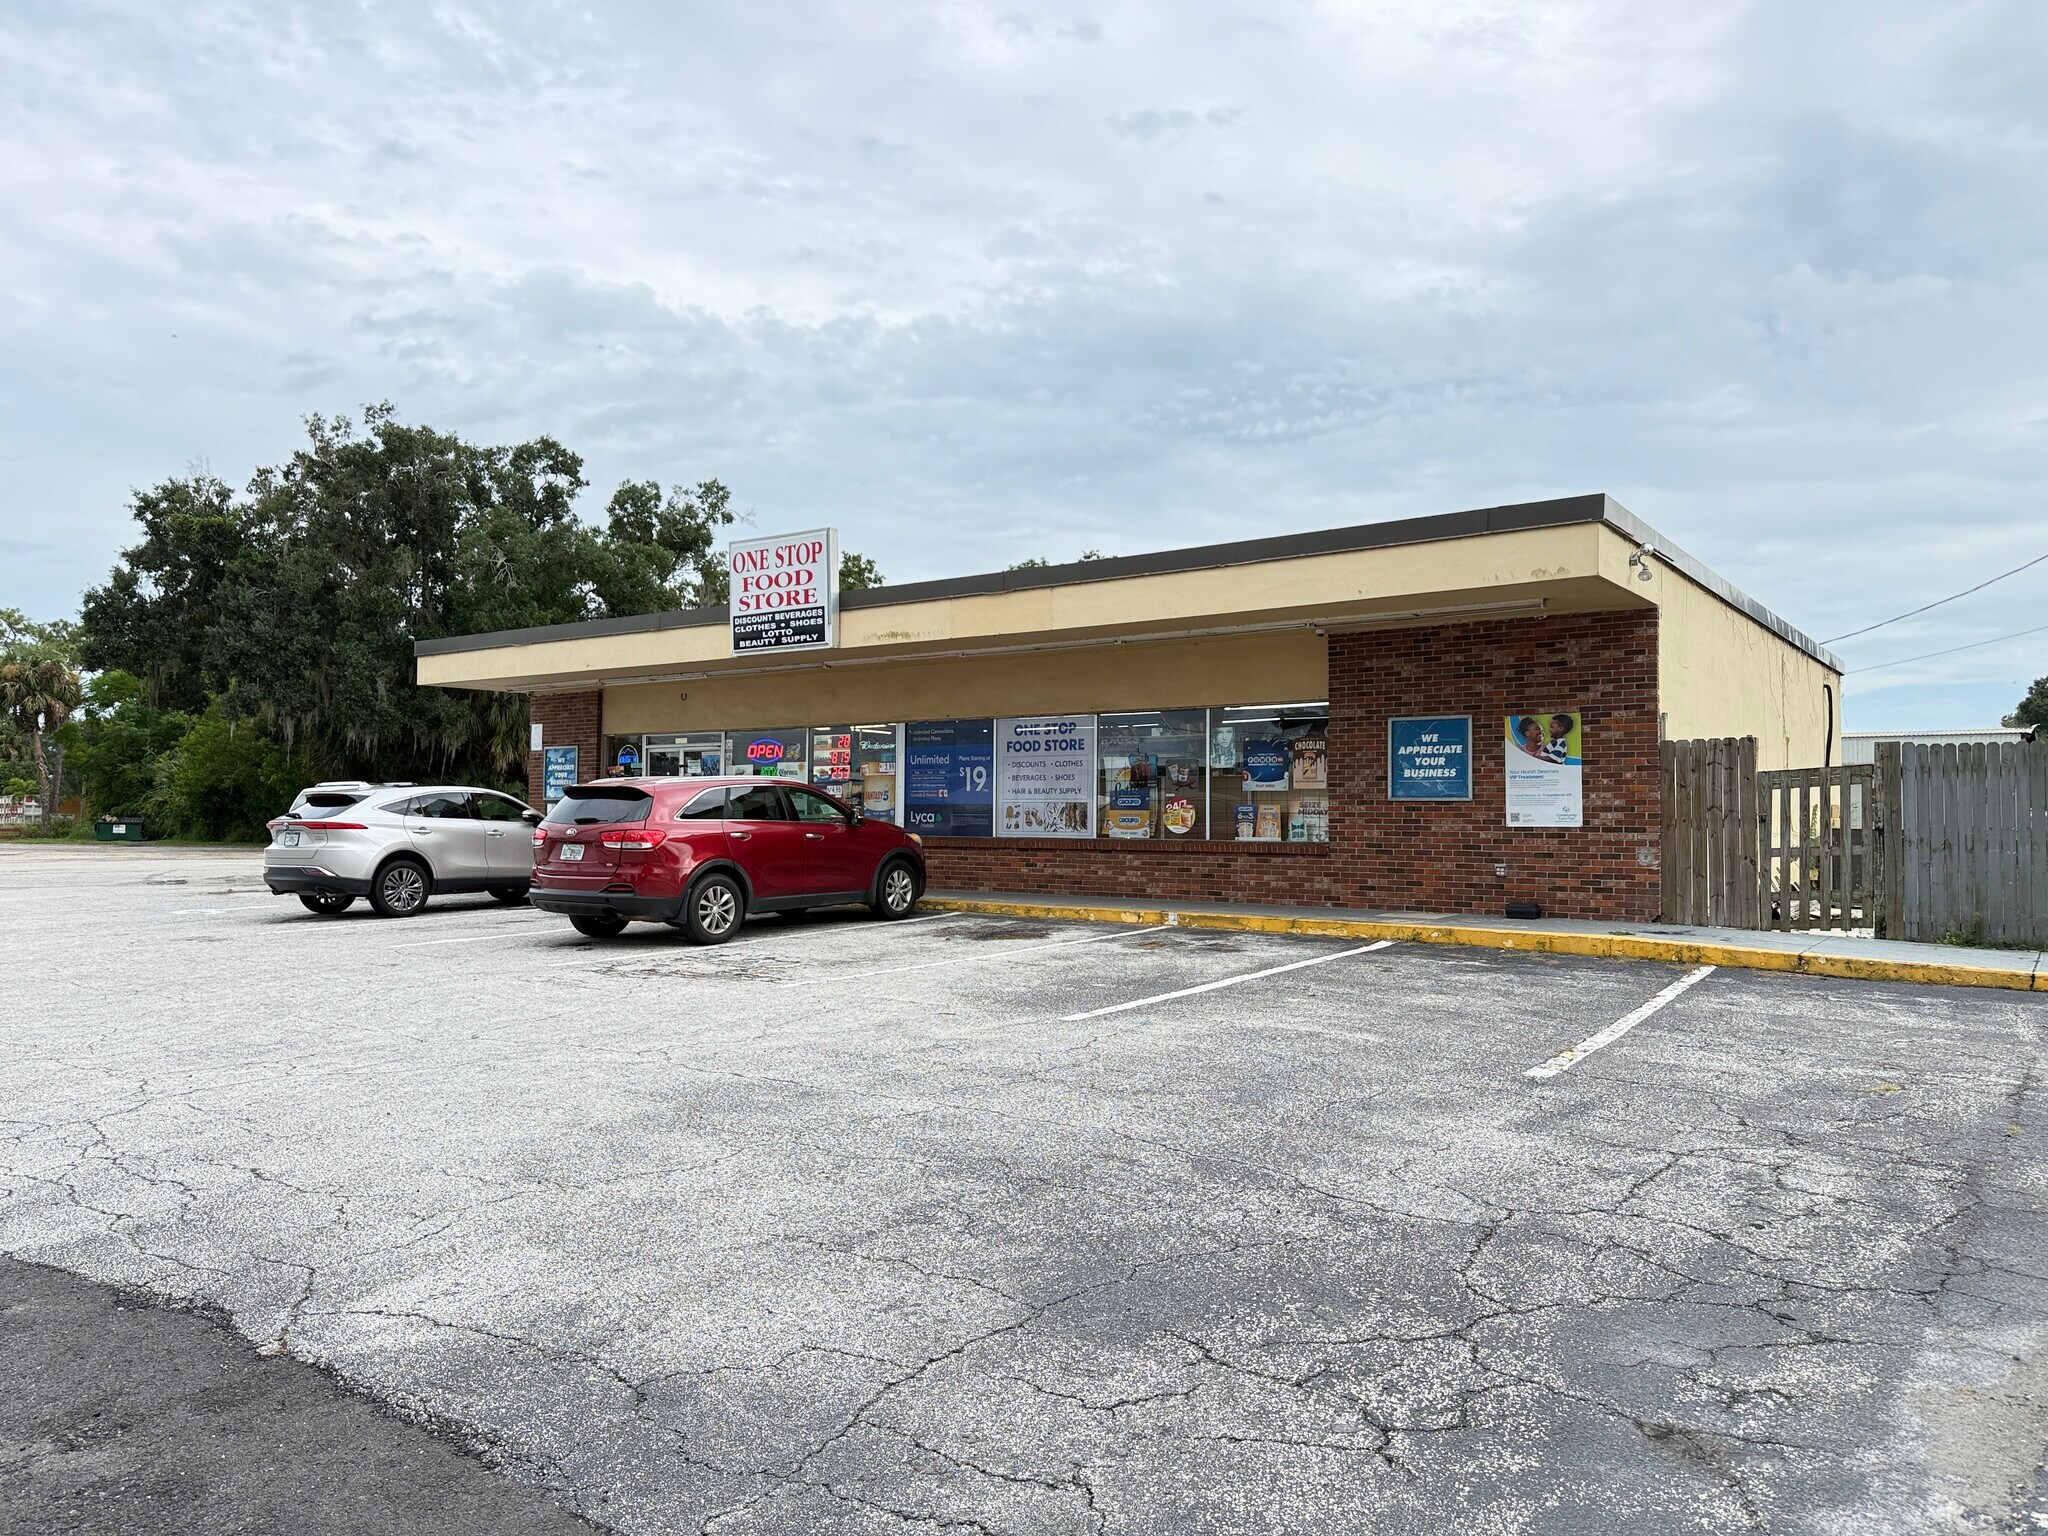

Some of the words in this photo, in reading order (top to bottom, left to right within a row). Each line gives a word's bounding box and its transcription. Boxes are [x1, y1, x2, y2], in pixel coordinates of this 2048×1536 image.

[733, 549, 769, 574] ONE
[775, 541, 822, 568] STOP
[742, 569, 813, 593] FOOD
[739, 588, 818, 612] STORE
[734, 614, 773, 625] DISCOUNT
[775, 609, 823, 621] BEVERAGES
[735, 623, 776, 633] CLOTHES
[790, 618, 823, 627] SHOES
[762, 629, 793, 637] LOTTO
[739, 638, 776, 647] BEAUTY
[781, 634, 818, 643] SUPPLY
[1014, 724, 1040, 736] ONE
[1044, 722, 1076, 735] STOP
[838, 736, 850, 747] 28
[1006, 740, 1040, 752] FOOD
[1044, 738, 1085, 751] STORE
[1421, 734, 1439, 743] WE
[747, 745, 784, 758] OPEN
[1295, 741, 1326, 750] CHOCOLATE
[1398, 745, 1463, 755] APPRECIATE
[832, 752, 850, 763] 815
[911, 754, 950, 765] Unlimited
[1415, 757, 1445, 766] YOUR
[832, 768, 850, 779] 253
[959, 766, 987, 791] $19
[1404, 768, 1456, 778] BUSINESS
[865, 791, 883, 800] FANTASY
[883, 790, 889, 801] 5
[1166, 799, 1186, 812] 24/7
[910, 811, 934, 824] Lyca
